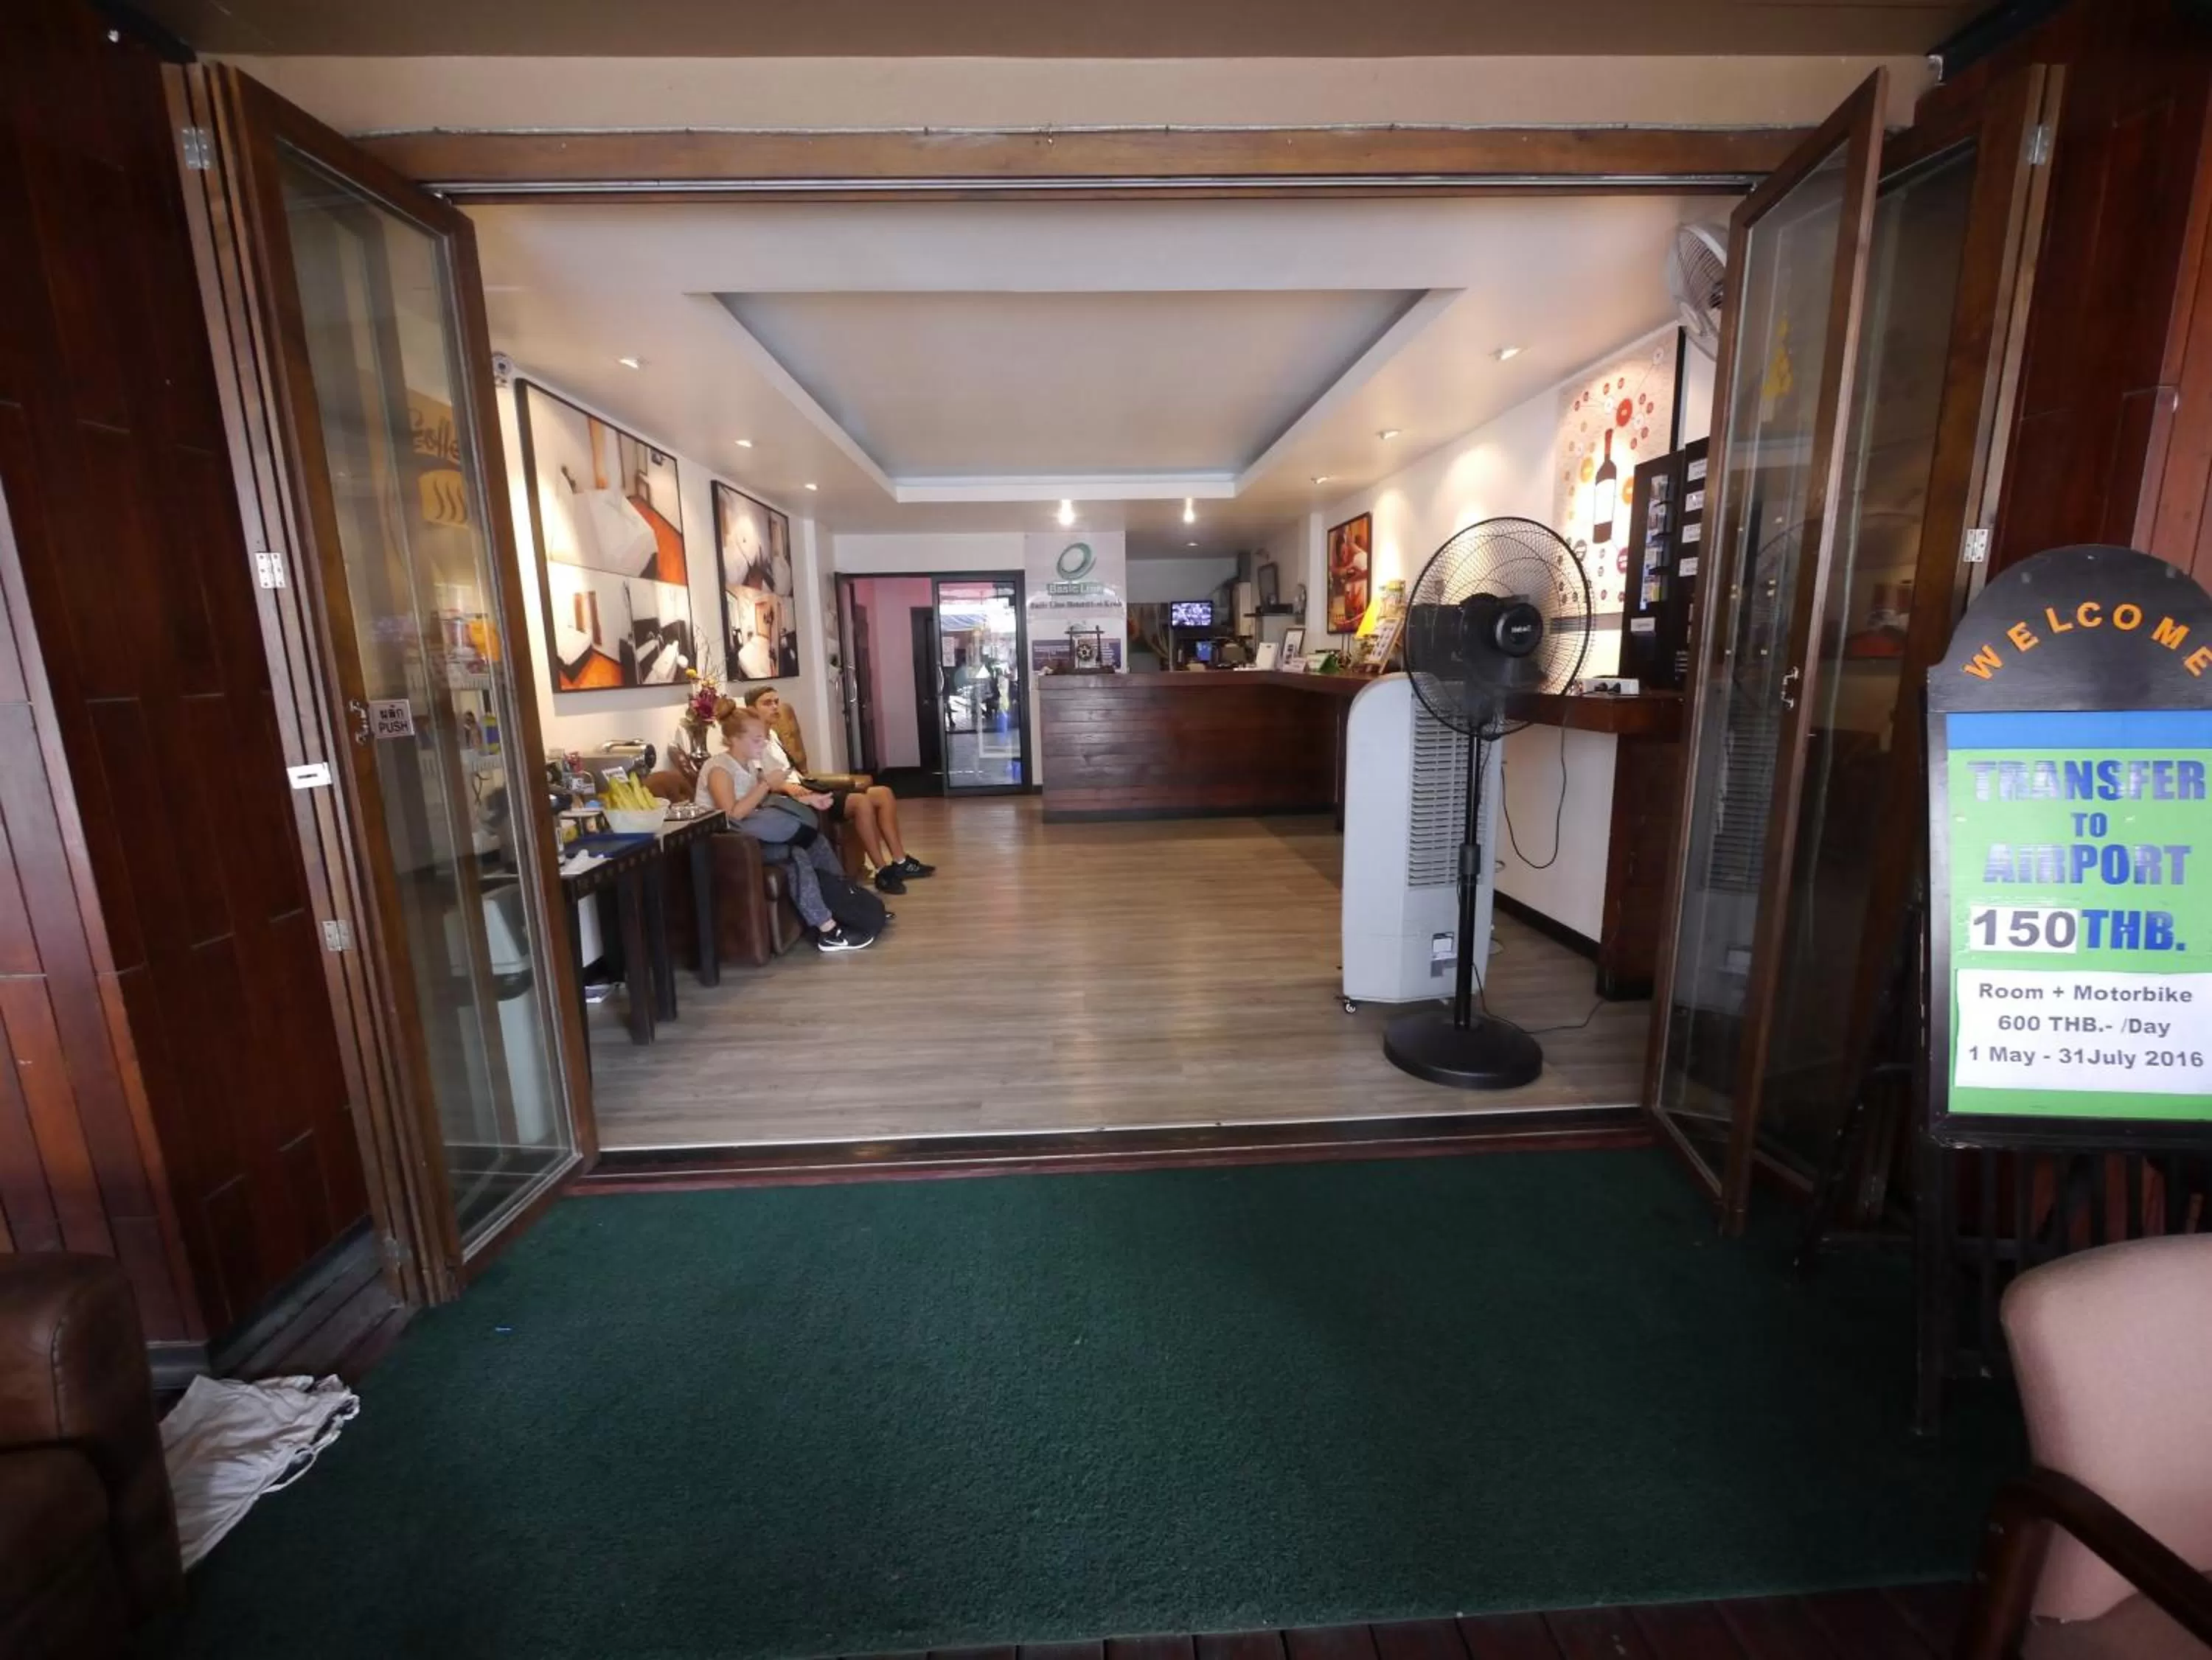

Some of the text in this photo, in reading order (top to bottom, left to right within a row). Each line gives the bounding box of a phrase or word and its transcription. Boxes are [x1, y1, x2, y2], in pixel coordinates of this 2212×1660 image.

[1962, 601, 2212, 680] WELCOME
[378, 720, 408, 733] PUSH
[1966, 760, 2206, 801] TRANSFER
[2070, 812, 2107, 837] TO
[1983, 844, 2192, 885] AIRPORT
[1973, 909, 2186, 951] 150 THB.
[1979, 983, 2193, 1002] Room + Motorbike
[1998, 1015, 2041, 1030] 600
[2121, 1017, 2171, 1038] /Day
[1969, 1045, 1978, 1061] 1
[1989, 1046, 2036, 1066] May
[2059, 1048, 2136, 1069] 31July
[2144, 1050, 2204, 1067] 2016
